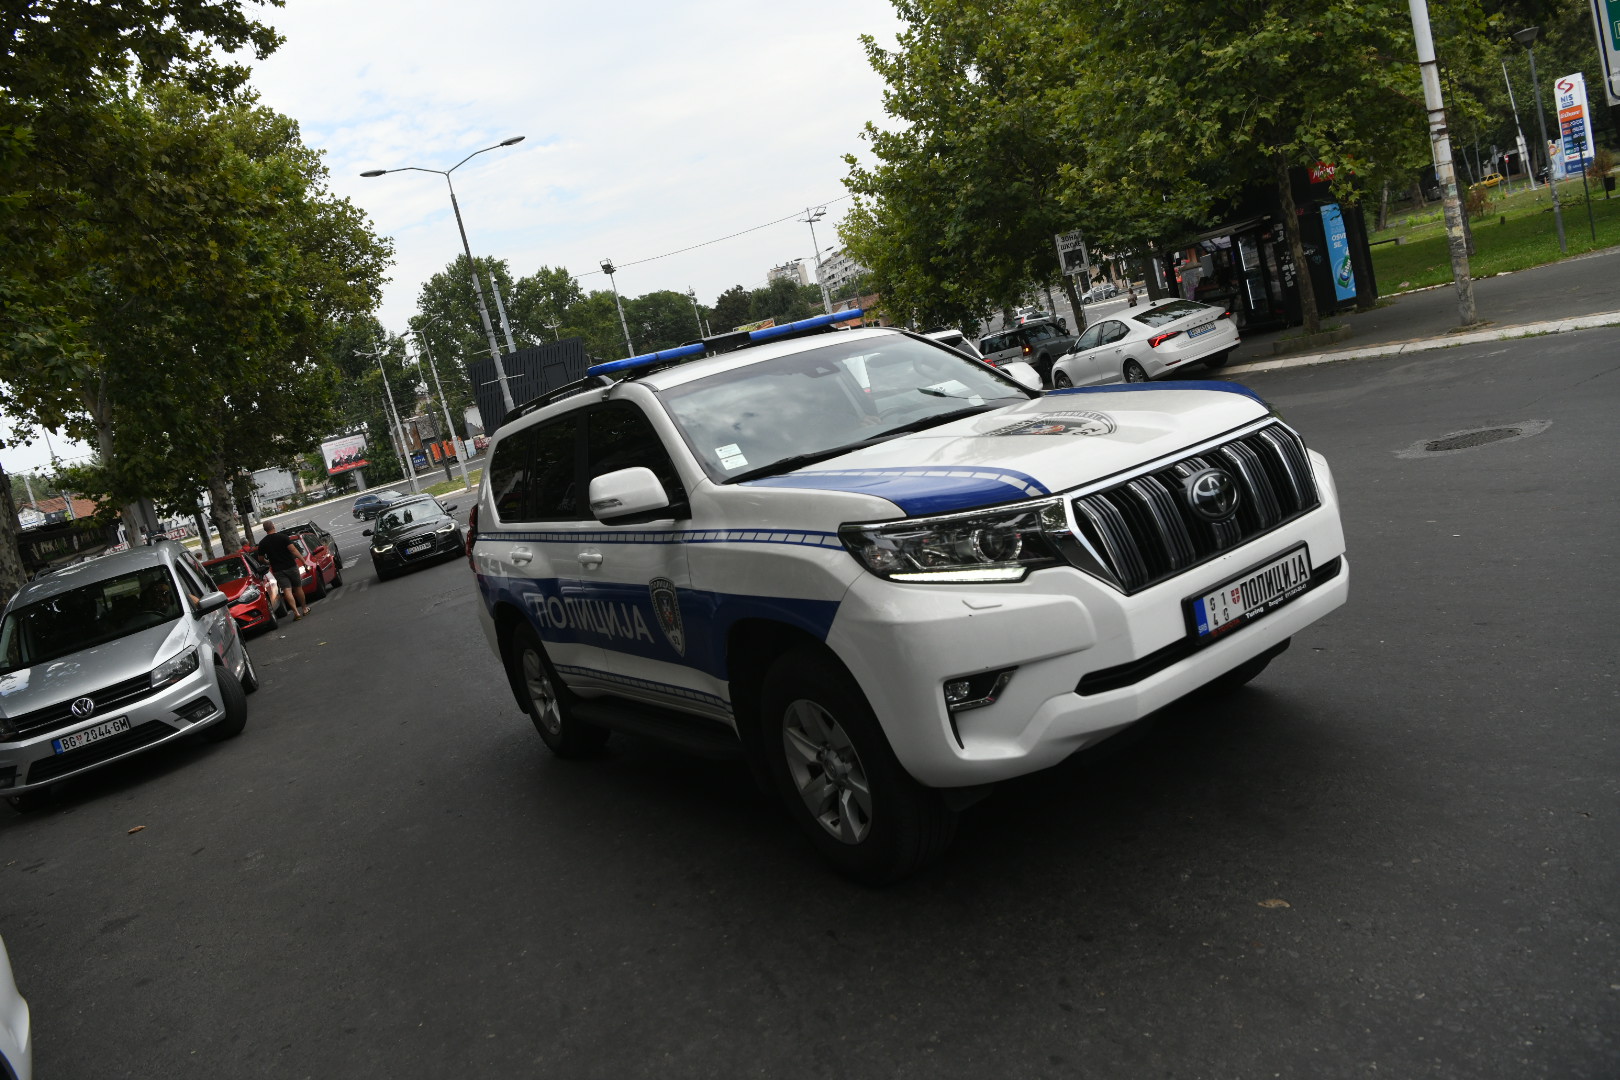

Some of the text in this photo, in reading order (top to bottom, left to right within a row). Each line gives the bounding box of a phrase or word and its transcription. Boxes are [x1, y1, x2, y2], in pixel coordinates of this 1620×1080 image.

[1560, 94, 1574, 103] NIS
[1060, 234, 1078, 243] ЗОНА
[1331, 232, 1347, 242] OSVE
[1240, 554, 1308, 611] ПОЛИЦИЈА
[533, 595, 655, 644] ПОЛИЦИЈА
[61, 736, 77, 750] BG
